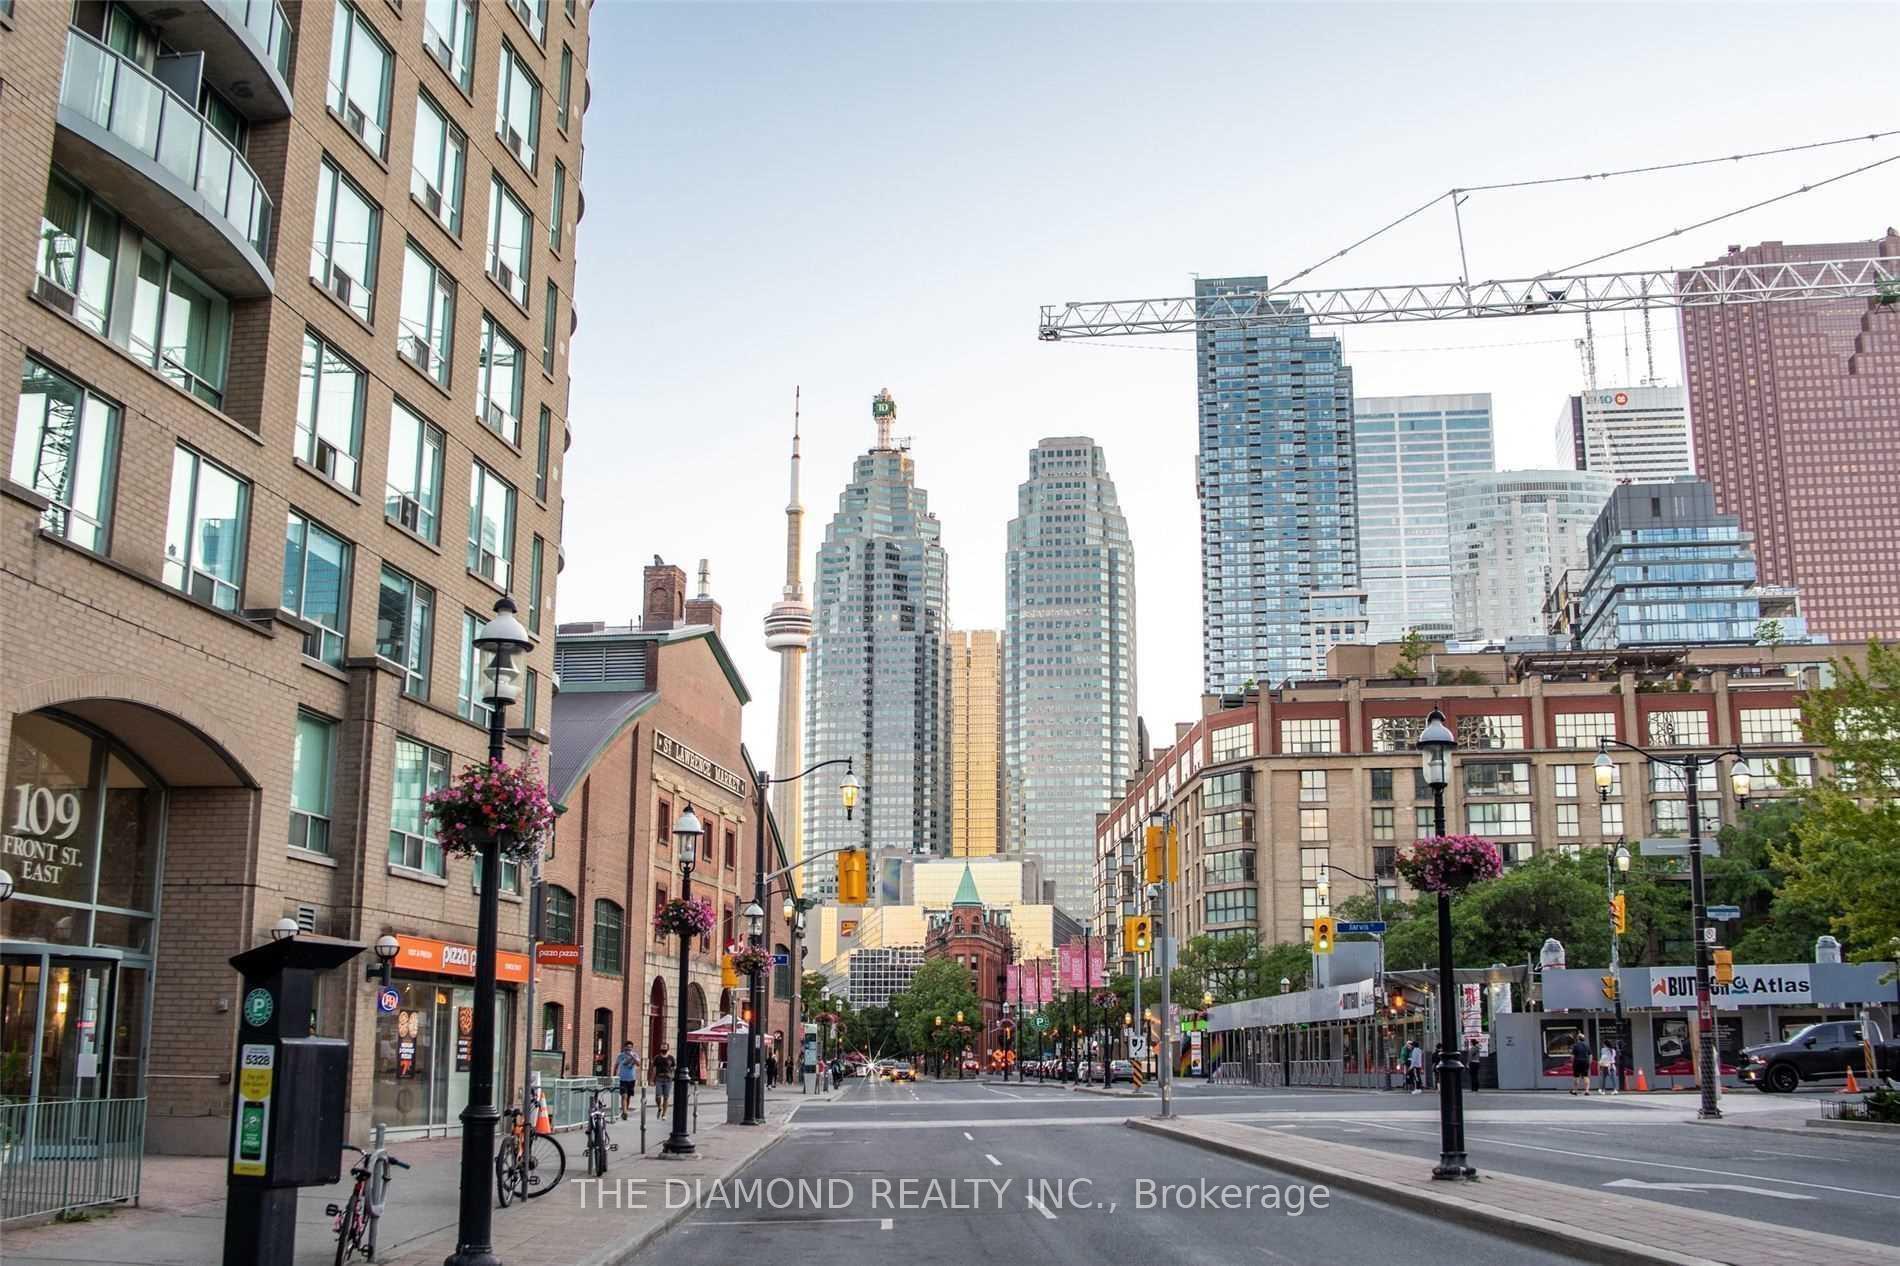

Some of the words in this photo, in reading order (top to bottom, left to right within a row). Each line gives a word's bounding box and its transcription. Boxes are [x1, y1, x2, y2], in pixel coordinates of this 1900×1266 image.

[675, 744, 712, 777] LAWRENCE
[714, 766, 741, 793] MARKET
[11, 783, 80, 839] 109
[3, 835, 58, 862] FRONT
[61, 846, 83, 867] ST.
[22, 860, 62, 884] EAST
[442, 946, 469, 969] pizza
[559, 951, 578, 959] pizza
[1752, 977, 1810, 993] Atlas
[245, 1054, 270, 1066] 5328
